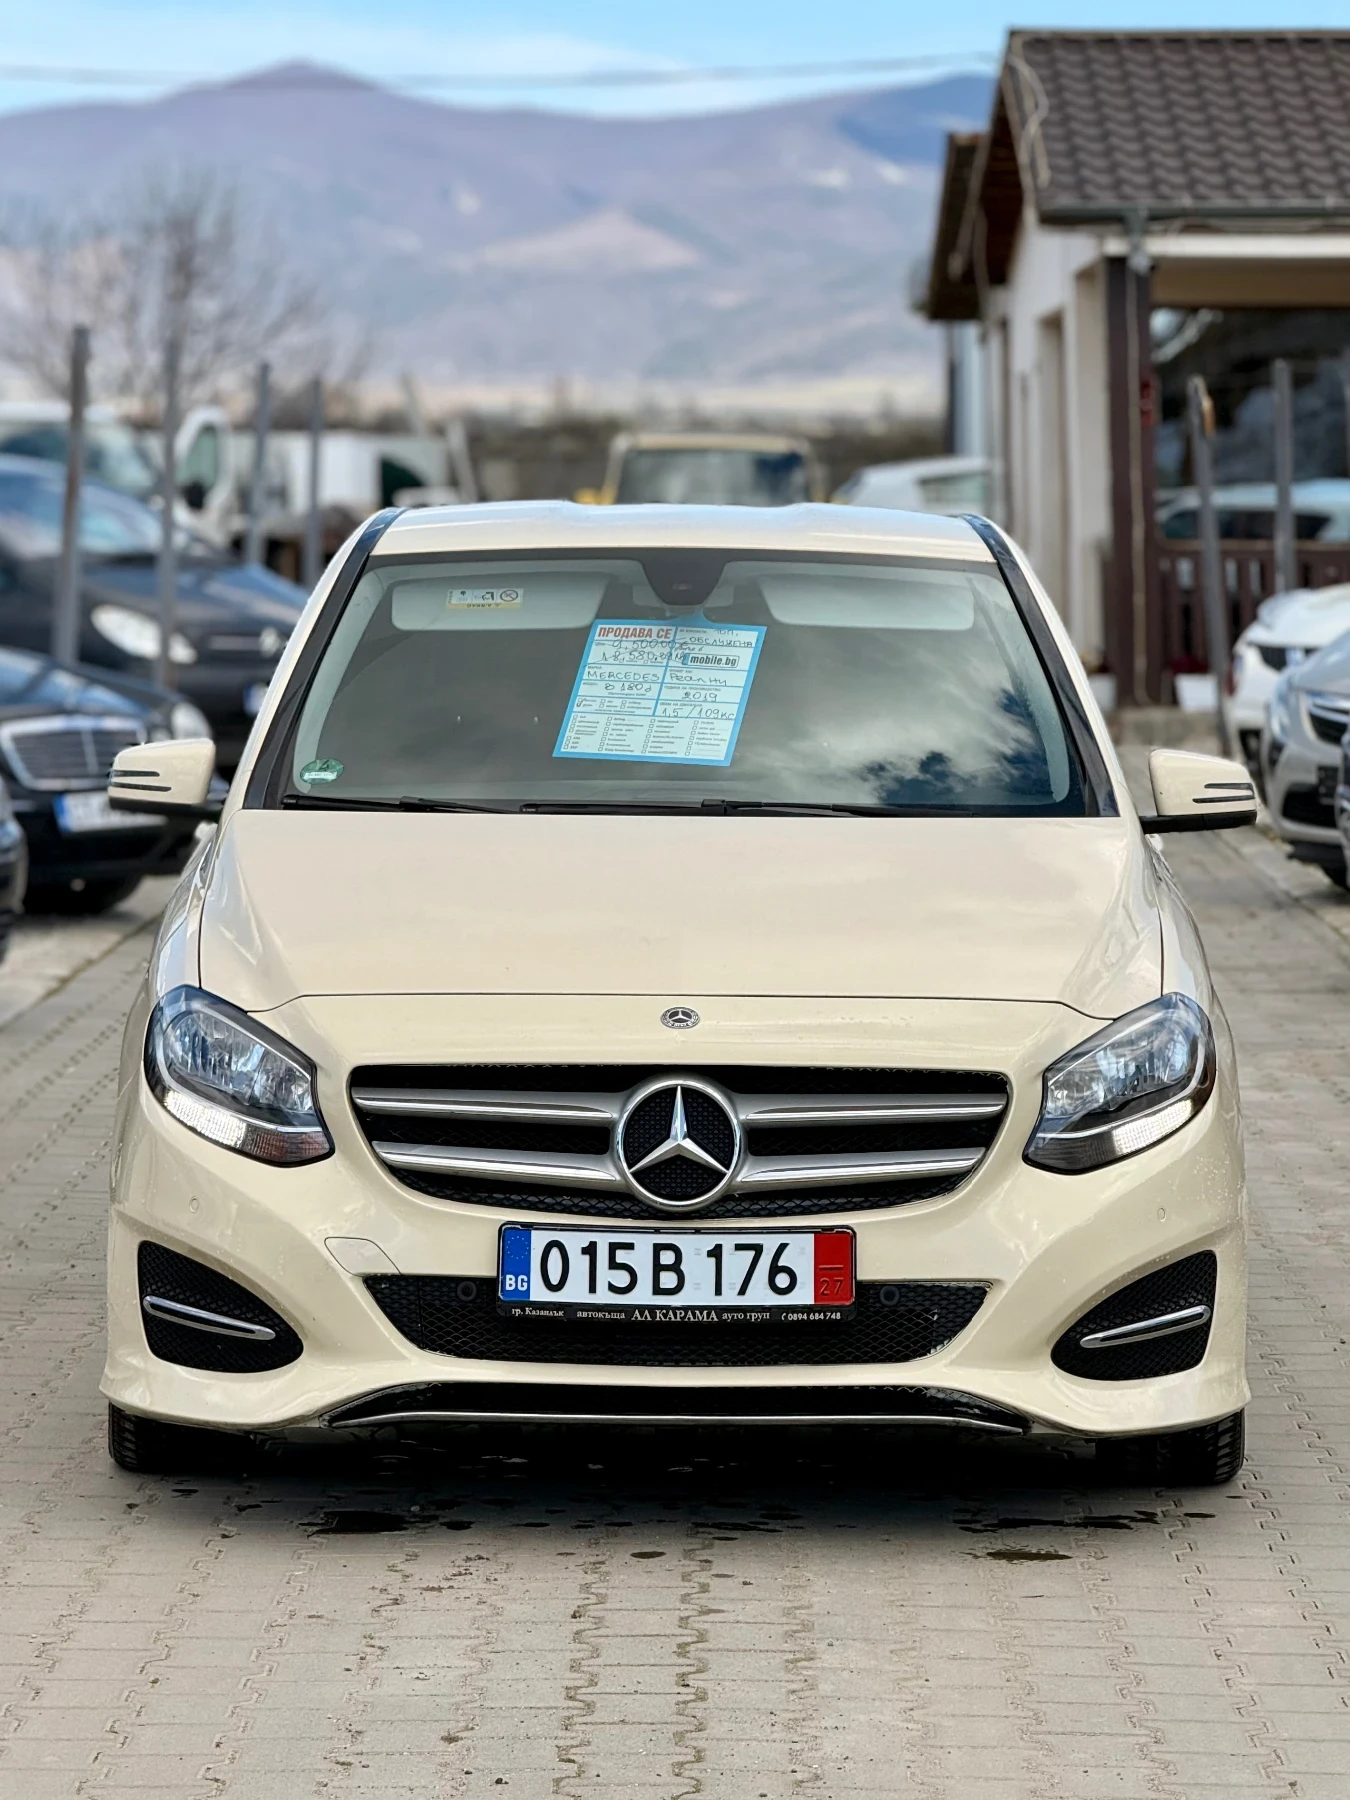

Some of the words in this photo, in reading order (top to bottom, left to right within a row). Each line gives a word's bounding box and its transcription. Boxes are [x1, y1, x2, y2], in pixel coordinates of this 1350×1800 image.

[598, 627, 653, 640] ПРОДАВА
[656, 628, 672, 640] СЕ
[690, 654, 737, 667] mobile.bg
[587, 671, 660, 682] MERCEDES
[682, 691, 718, 702] 2019
[505, 1275, 528, 1291] BG
[819, 1277, 844, 1296] 27
[525, 1307, 565, 1317] Казанлък
[576, 1310, 626, 1320] автокъща
[631, 1309, 652, 1321] АЛ
[655, 1309, 719, 1322] КАРАМА
[721, 1312, 744, 1322] ауто
[746, 1311, 770, 1323] груп
[809, 1312, 824, 1320] 684
[825, 1312, 841, 1320] 748
